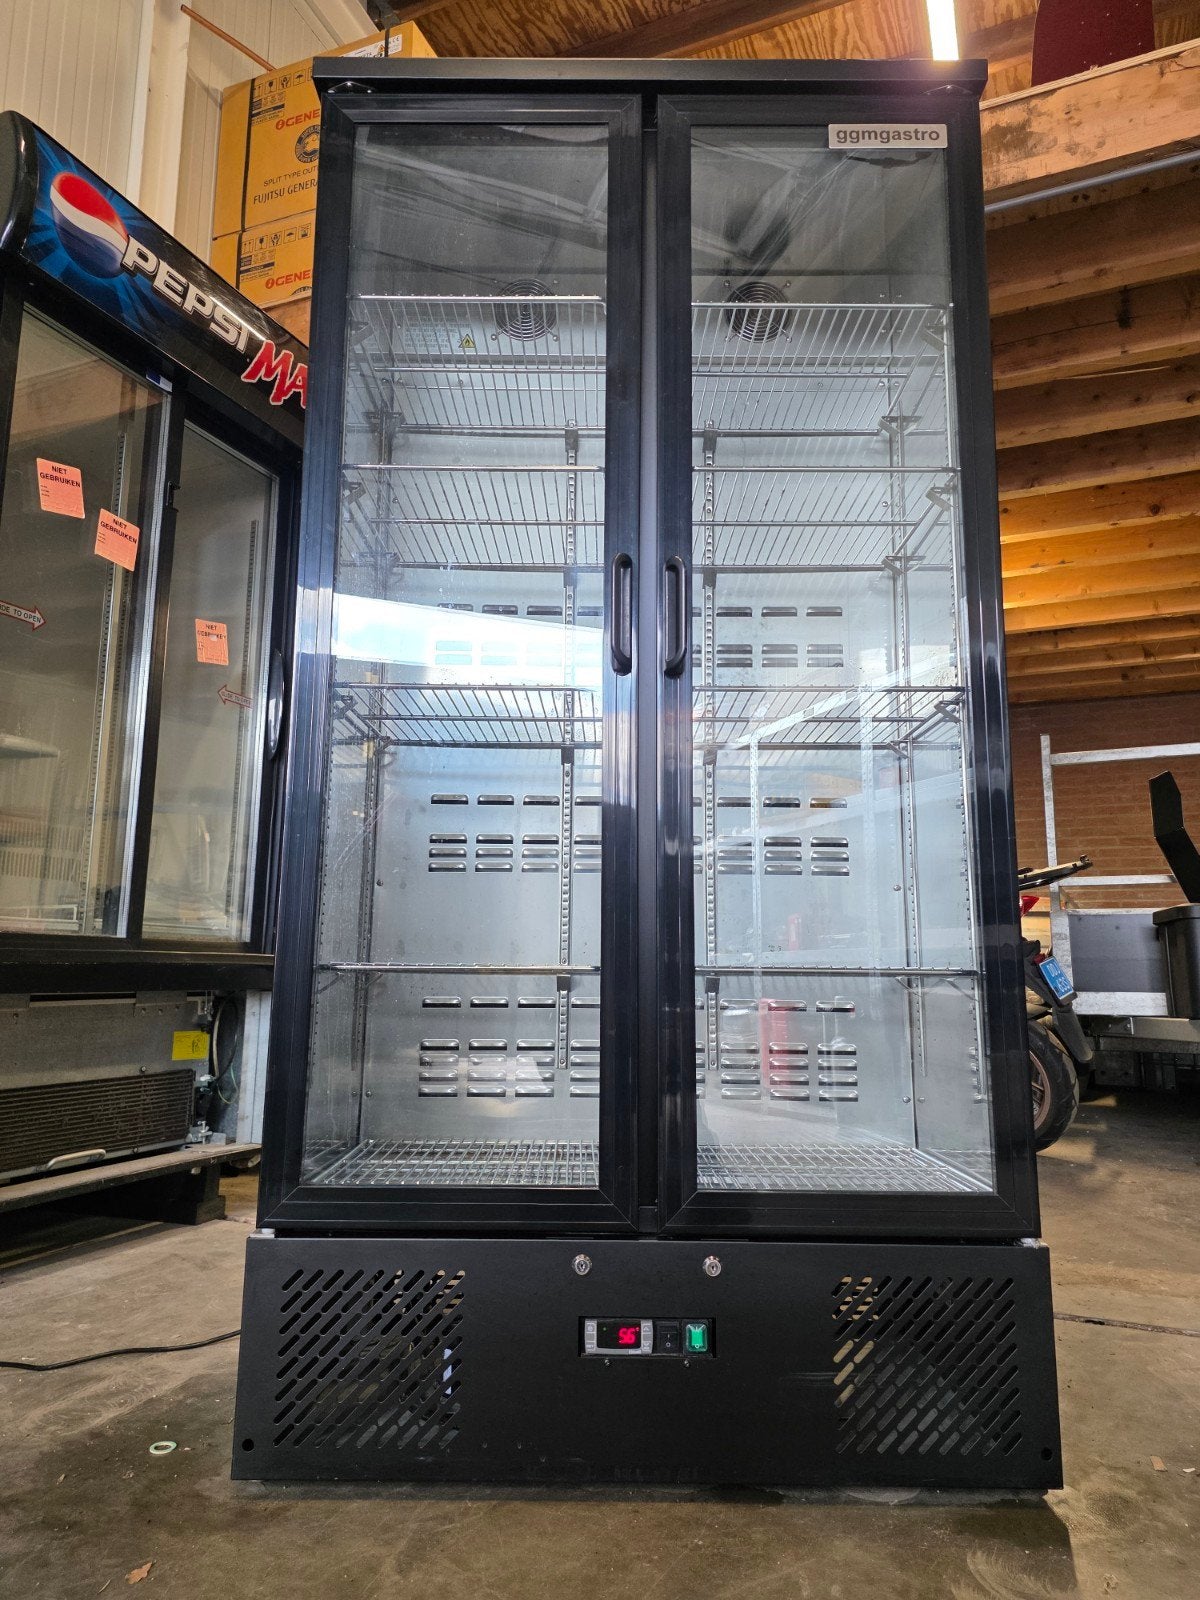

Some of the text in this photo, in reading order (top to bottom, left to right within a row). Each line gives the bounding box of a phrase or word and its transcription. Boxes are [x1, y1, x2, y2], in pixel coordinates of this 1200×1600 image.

[836, 128, 940, 144] ggmgastro
[263, 175, 281, 188] SPLIT
[283, 171, 301, 181] TYPE
[253, 187, 286, 205] FUJITSU
[120, 236, 250, 353] PEPSI
[51, 465, 67, 474] NIET
[39, 472, 81, 487] GEBRUIKEN
[112, 518, 127, 529] NIET
[100, 521, 137, 544] GEBRUIKEN
[13, 608, 22, 617] TO
[23, 612, 41, 624] OPEN
